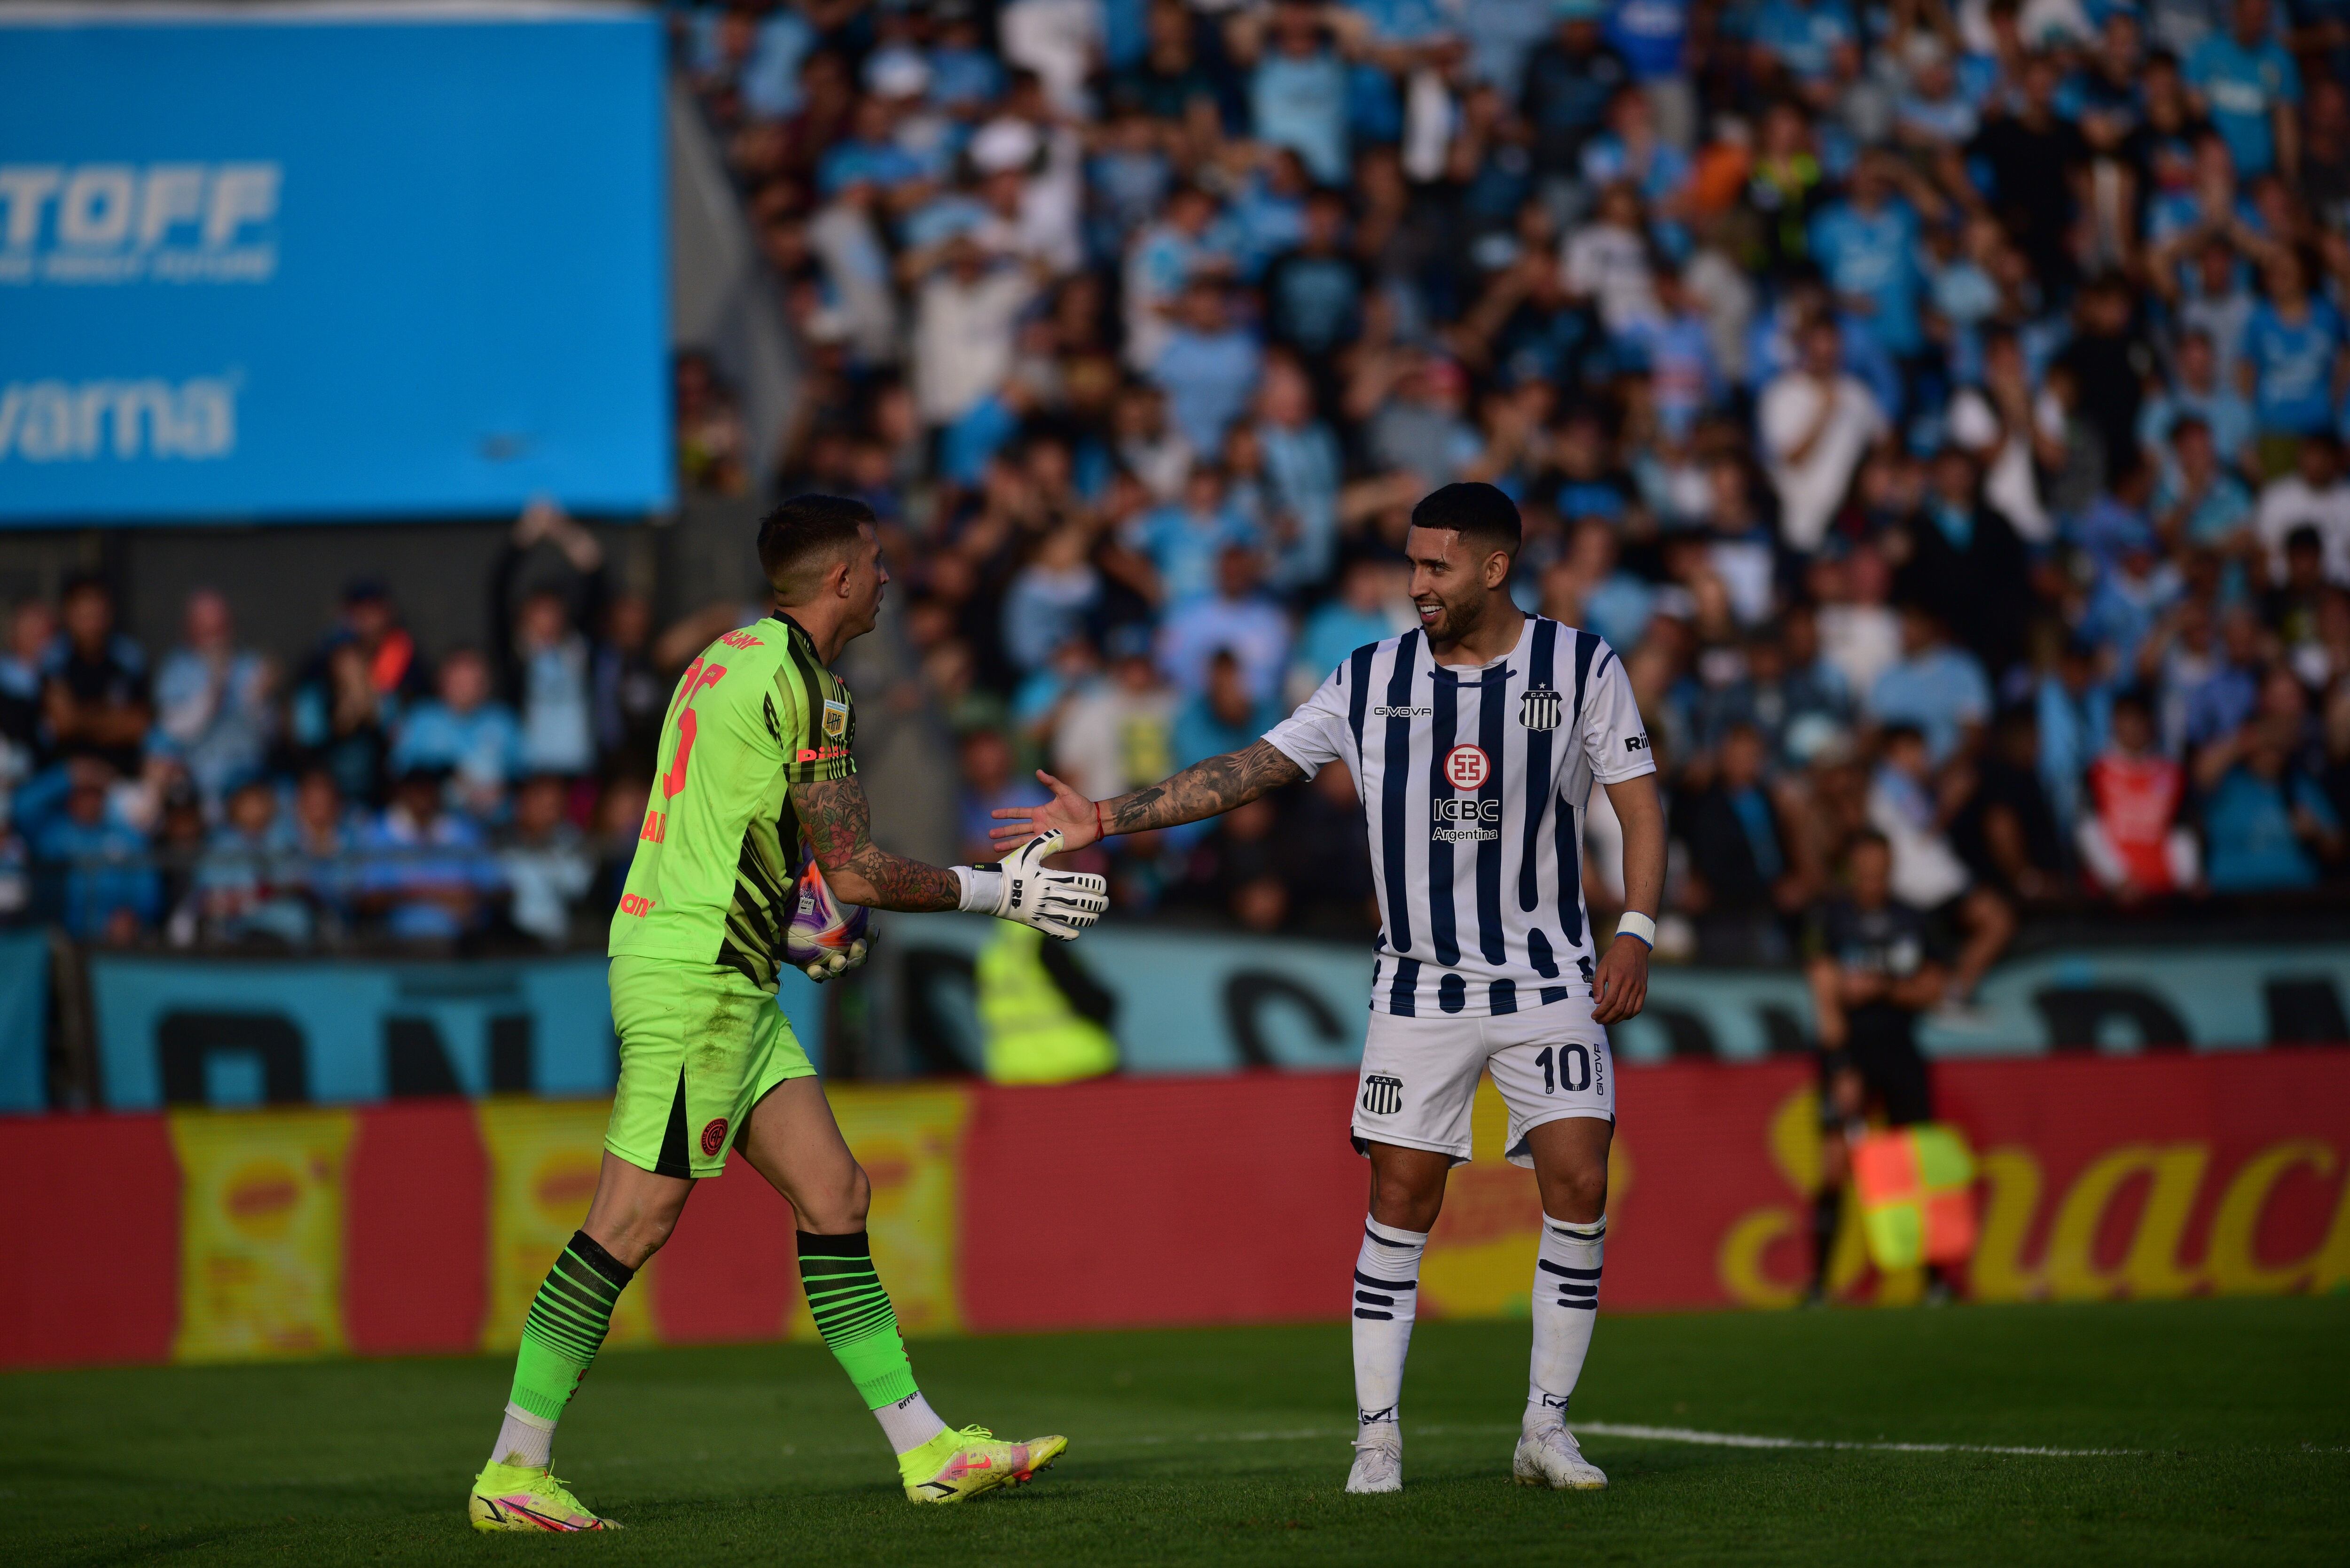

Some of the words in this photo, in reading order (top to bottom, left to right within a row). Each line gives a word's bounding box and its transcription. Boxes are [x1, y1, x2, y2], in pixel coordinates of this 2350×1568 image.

[1373, 706, 1433, 717] GIVOVA
[1434, 799, 1498, 821] ICBC
[1432, 827, 1498, 843] Argentina
[1011, 879, 1023, 909] DRB
[1535, 1044, 1591, 1094] 10
[1594, 1044, 1604, 1096] GIVOVA
